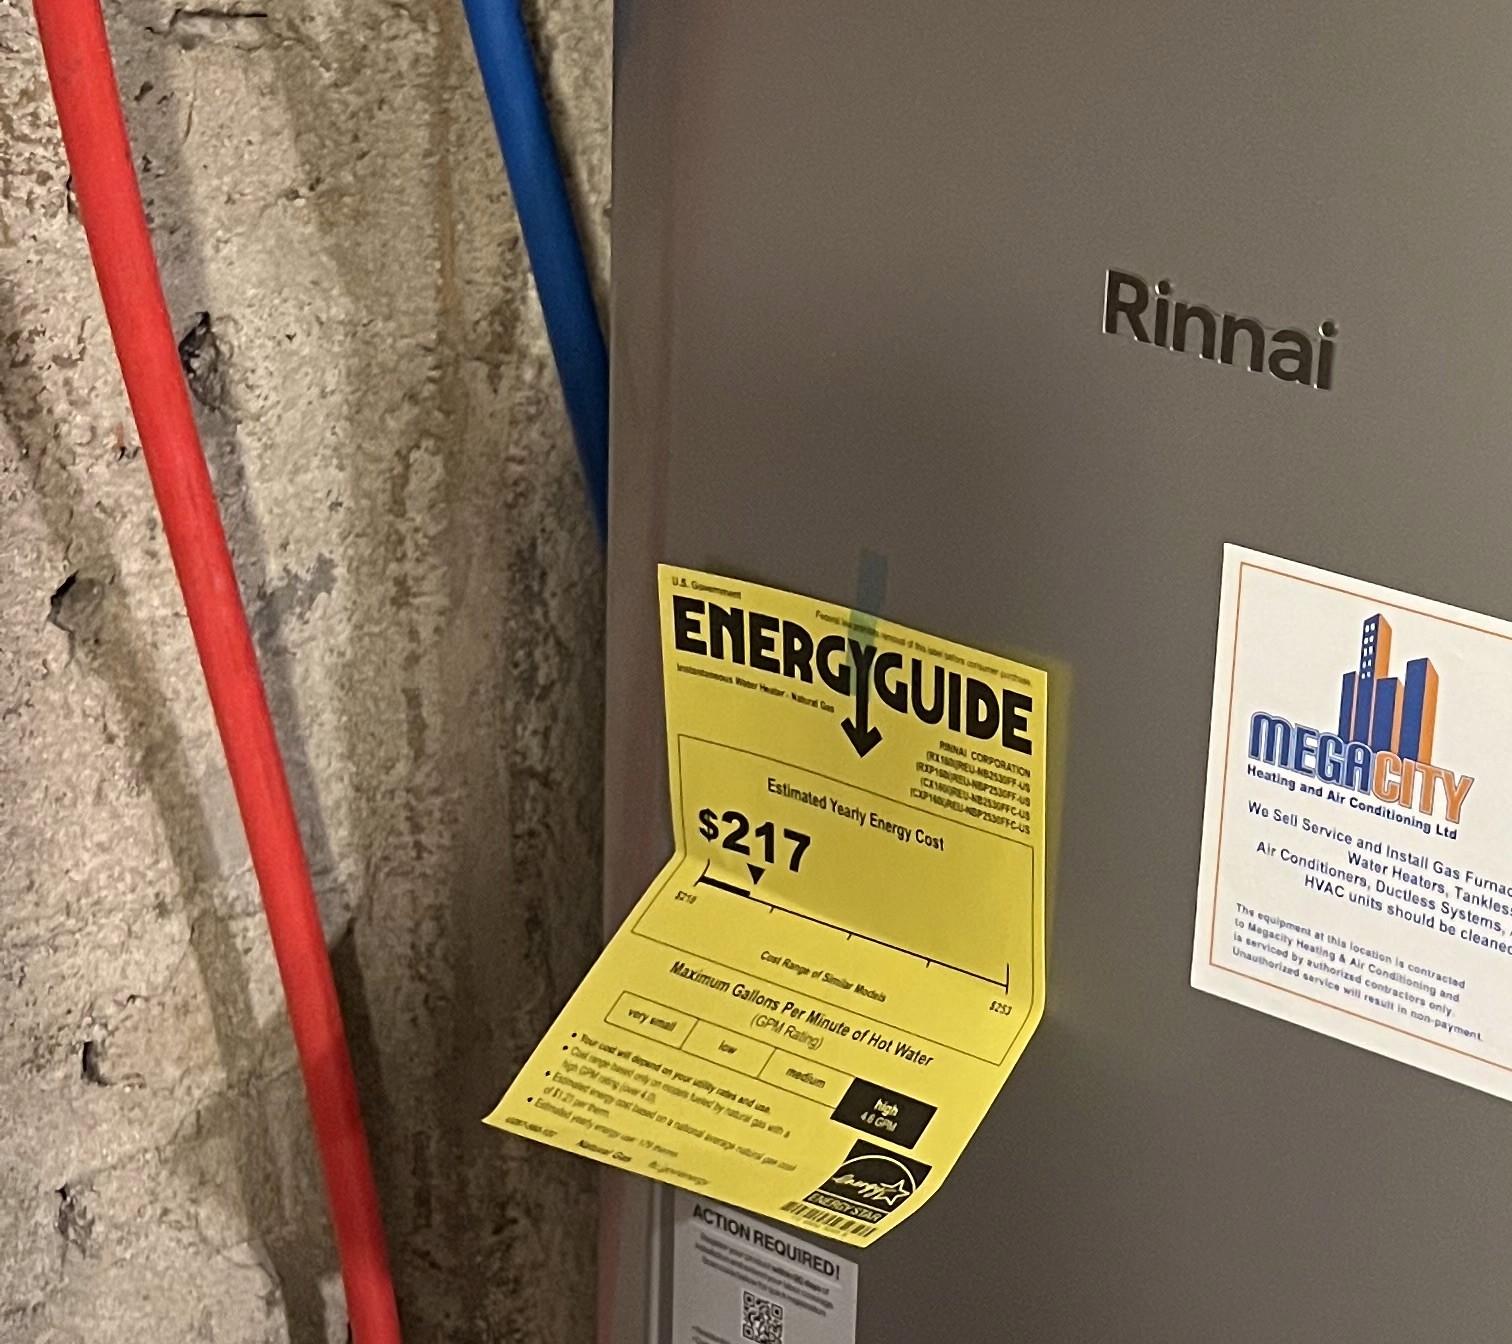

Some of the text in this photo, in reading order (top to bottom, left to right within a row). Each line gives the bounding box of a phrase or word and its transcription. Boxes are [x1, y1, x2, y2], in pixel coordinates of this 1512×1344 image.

[1102, 269, 1338, 391] Rinnai
[820, 701, 835, 713] Gas
[971, 751, 1030, 778] CORPORATION
[1248, 711, 1475, 824] MEGACITY
[767, 777, 945, 851] Estimated Yearly Energy Cost
[1247, 764, 1457, 841] Heating and Air Conditioning Ltd
[698, 808, 811, 873] $217
[1248, 799, 1269, 818] We
[1273, 808, 1298, 828] Sell
[1302, 818, 1353, 845] Service
[1357, 837, 1382, 854] and
[1386, 845, 1428, 870] Install
[1433, 860, 1460, 880] Gas
[1257, 841, 1276, 857] Air
[1280, 848, 1371, 891] Conditioners,
[1376, 879, 1435, 911] Ductless
[1441, 902, 1506, 936] Systems,
[1304, 874, 1345, 898] HVAC
[1348, 892, 1383, 912] units
[1387, 905, 1435, 930] should
[1439, 918, 1456, 936] be
[1347, 851, 1388, 875] Water
[1392, 867, 1449, 898] Heaters,
[760, 950, 781, 966] Cost
[781, 957, 811, 976] Range
[811, 969, 823, 979] of
[822, 972, 854, 990] Similar
[1233, 932, 1243, 943] is
[1246, 937, 1289, 959] serviced
[1291, 951, 1304, 966] by
[1307, 956, 1362, 985] authorized
[1364, 978, 1426, 1007] contractors
[1235, 917, 1460, 1003] to Megacity Heating & Air Conditioning and
[1236, 902, 1466, 990] The equipment at this location is contracted
[669, 960, 934, 1068] Maximum Gallons Per Minute of Hot Water
[1232, 946, 1300, 978] Unauthorized
[1303, 972, 1340, 992] service
[1343, 985, 1361, 999] will
[1364, 992, 1394, 1011] result
[1397, 1004, 1408, 1016] in
[628, 1008, 649, 1024] very
[750, 1012, 824, 1051] (GPM Rating)
[786, 1067, 826, 1088] medium
[873, 1099, 899, 1118] high
[873, 1116, 898, 1132] GPM
[808, 1192, 882, 1223] ENERGY STAR
[693, 1203, 750, 1241] ACTION
[753, 1230, 840, 1281] REQUIRED!
